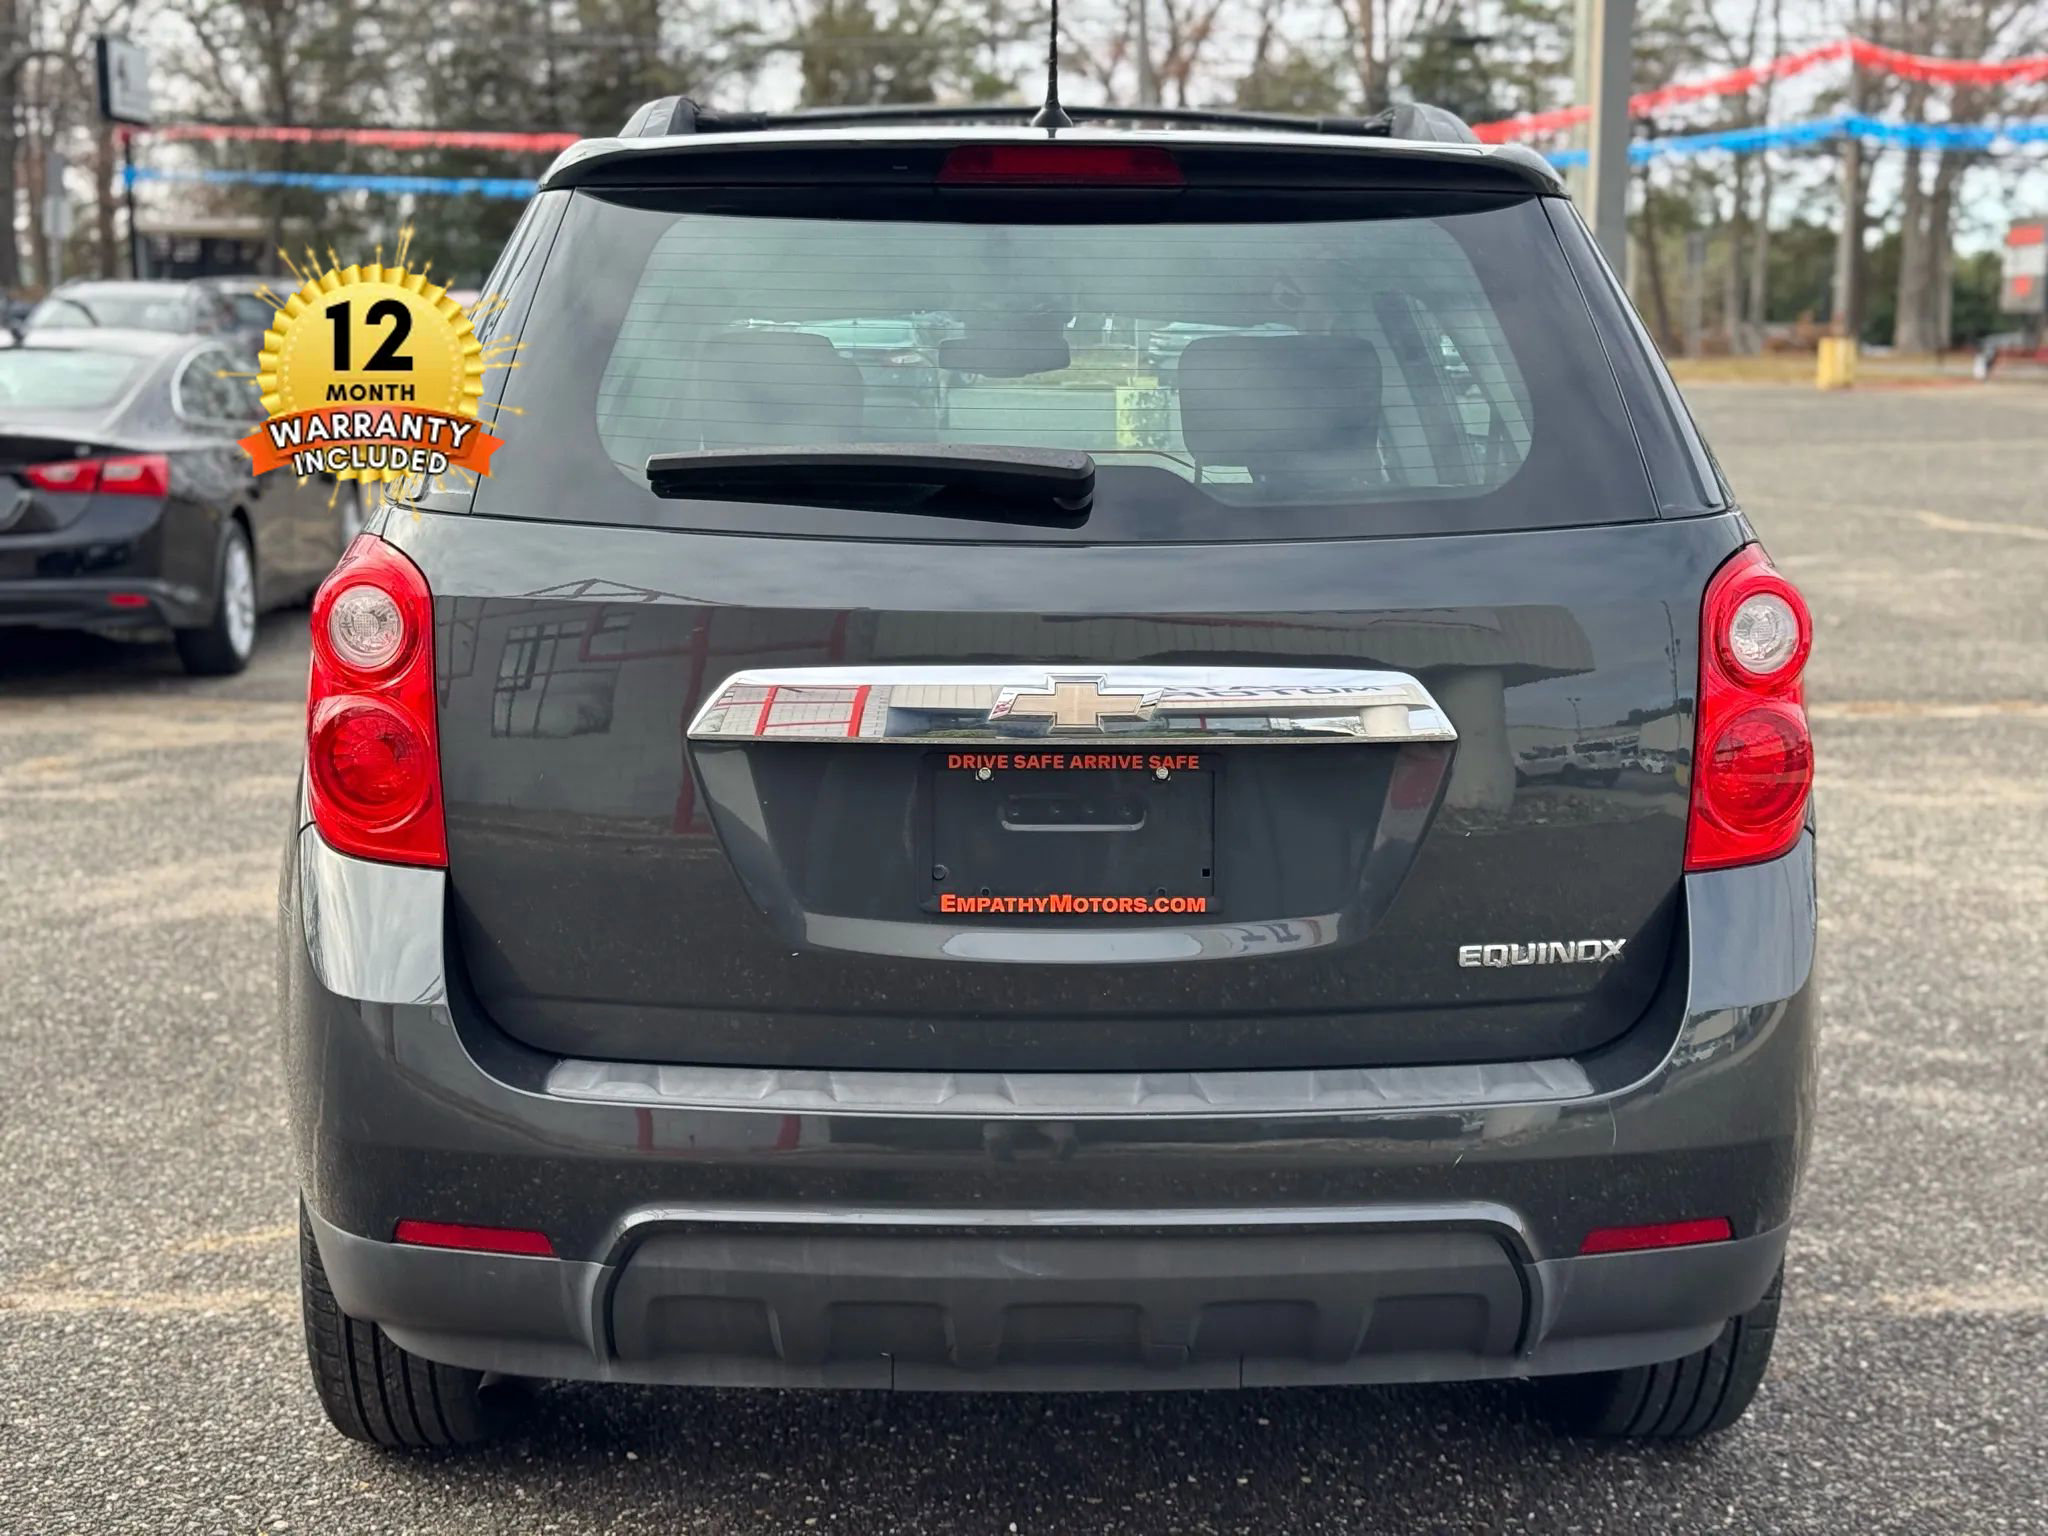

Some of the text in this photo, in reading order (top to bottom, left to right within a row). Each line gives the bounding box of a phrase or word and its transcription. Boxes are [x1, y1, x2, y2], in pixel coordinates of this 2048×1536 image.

[948, 754, 1200, 769] DRIVE SAFE ARRIVE SAFE
[1458, 938, 1627, 968] EQUINOX
